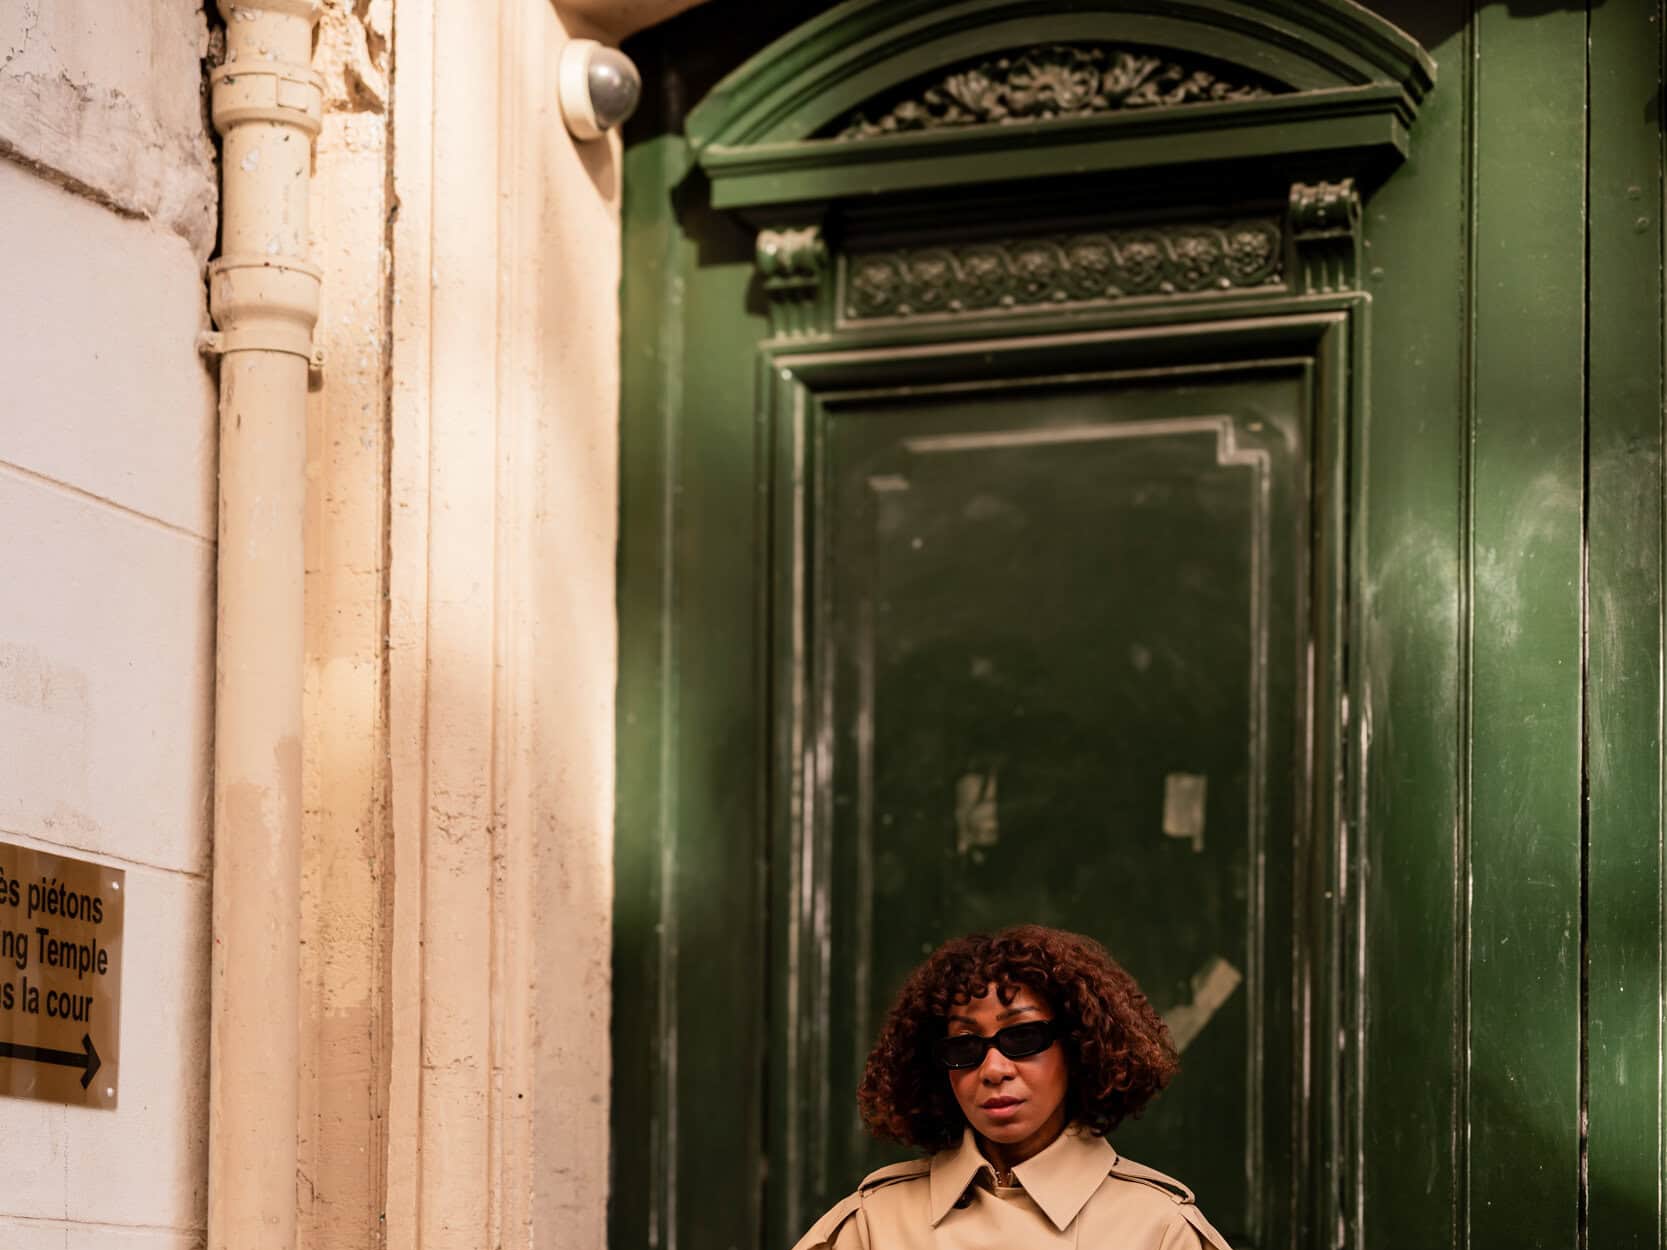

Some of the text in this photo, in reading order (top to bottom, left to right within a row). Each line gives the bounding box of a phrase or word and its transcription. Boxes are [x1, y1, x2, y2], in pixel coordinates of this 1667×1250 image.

[28, 877, 103, 924] piétons
[36, 927, 108, 979] Temple
[0, 976, 93, 1022] s la cour
